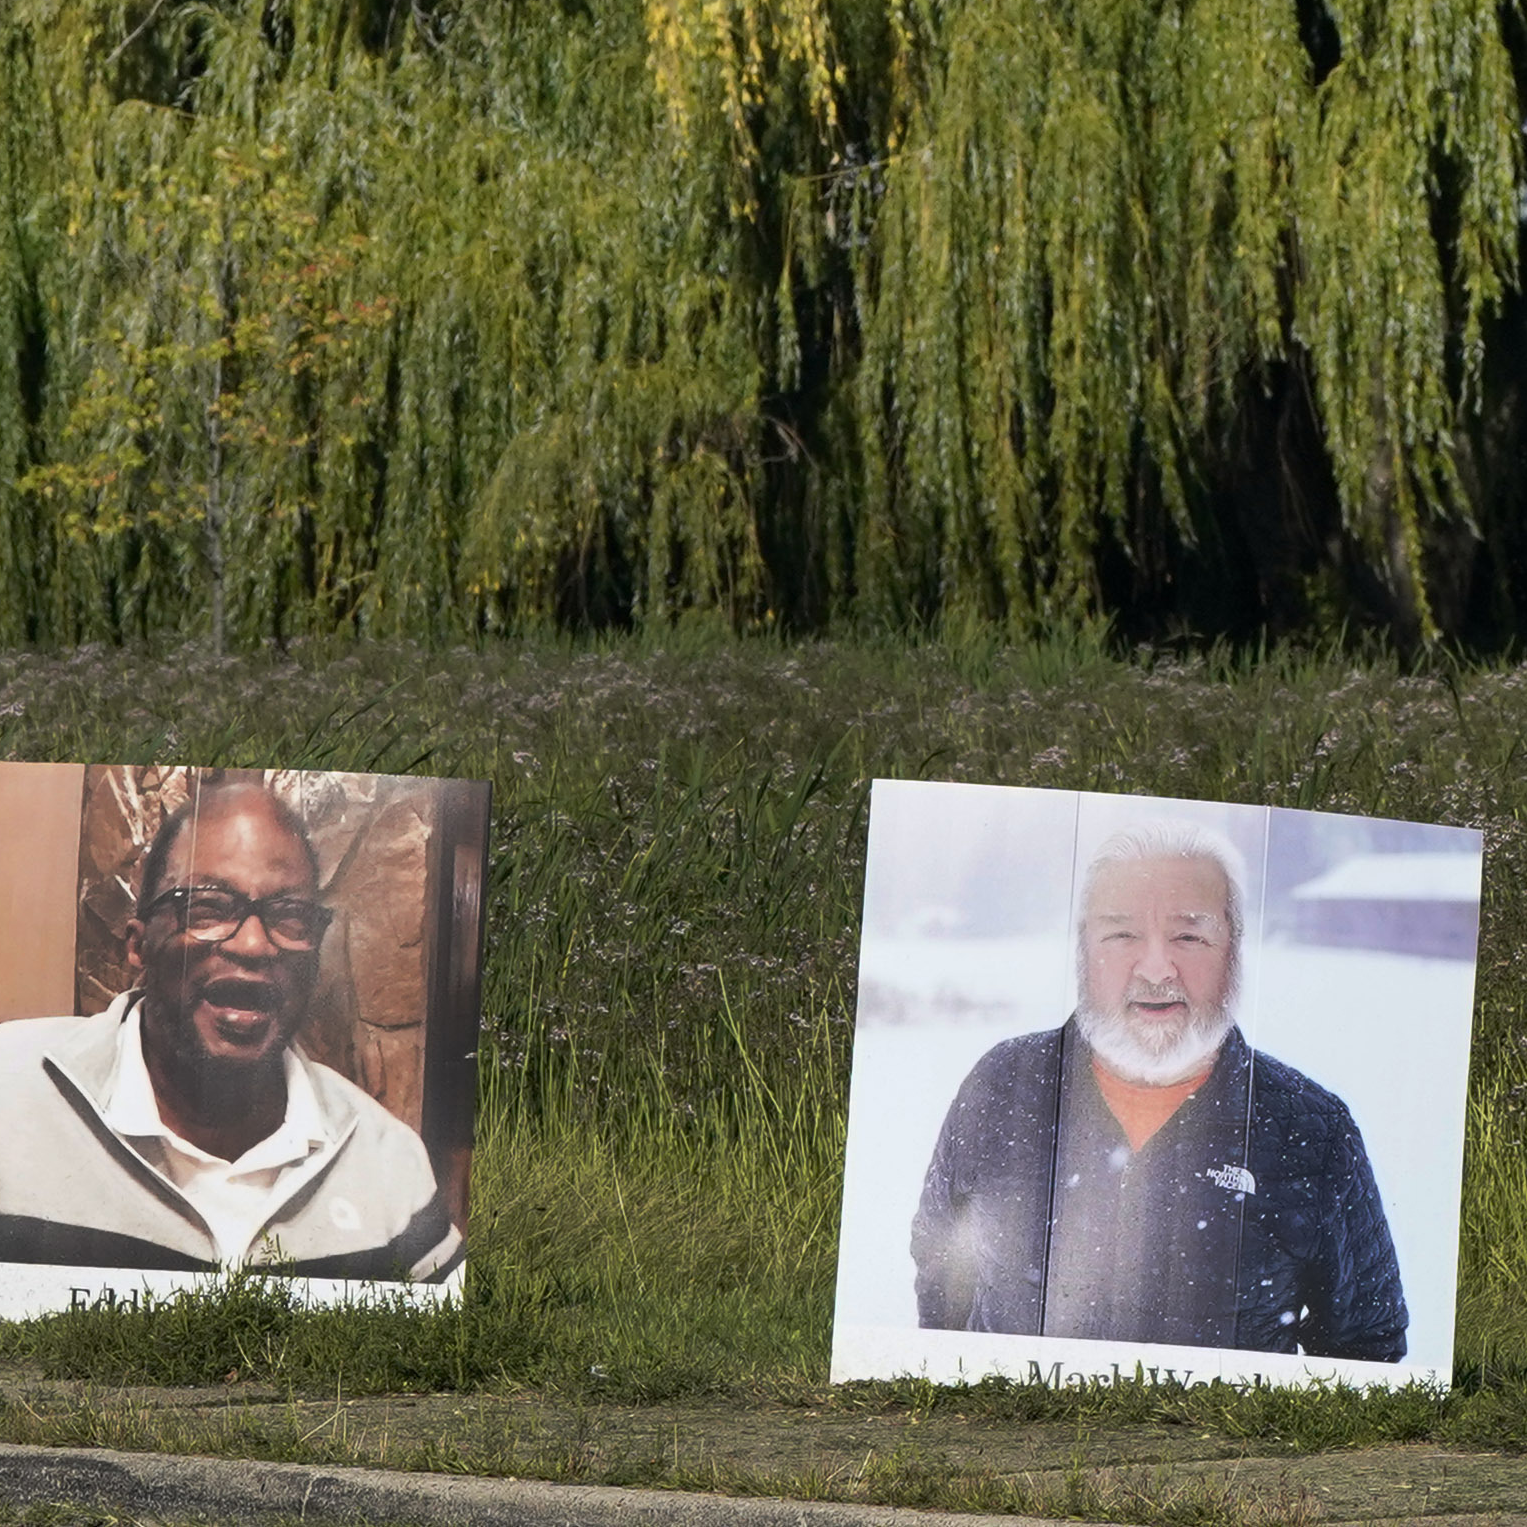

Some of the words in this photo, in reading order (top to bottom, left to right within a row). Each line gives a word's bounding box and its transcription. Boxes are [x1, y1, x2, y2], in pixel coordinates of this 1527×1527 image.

[1223, 1164, 1241, 1175] THE
[1206, 1168, 1239, 1184] NORTH
[1215, 1179, 1241, 1190] FACE
